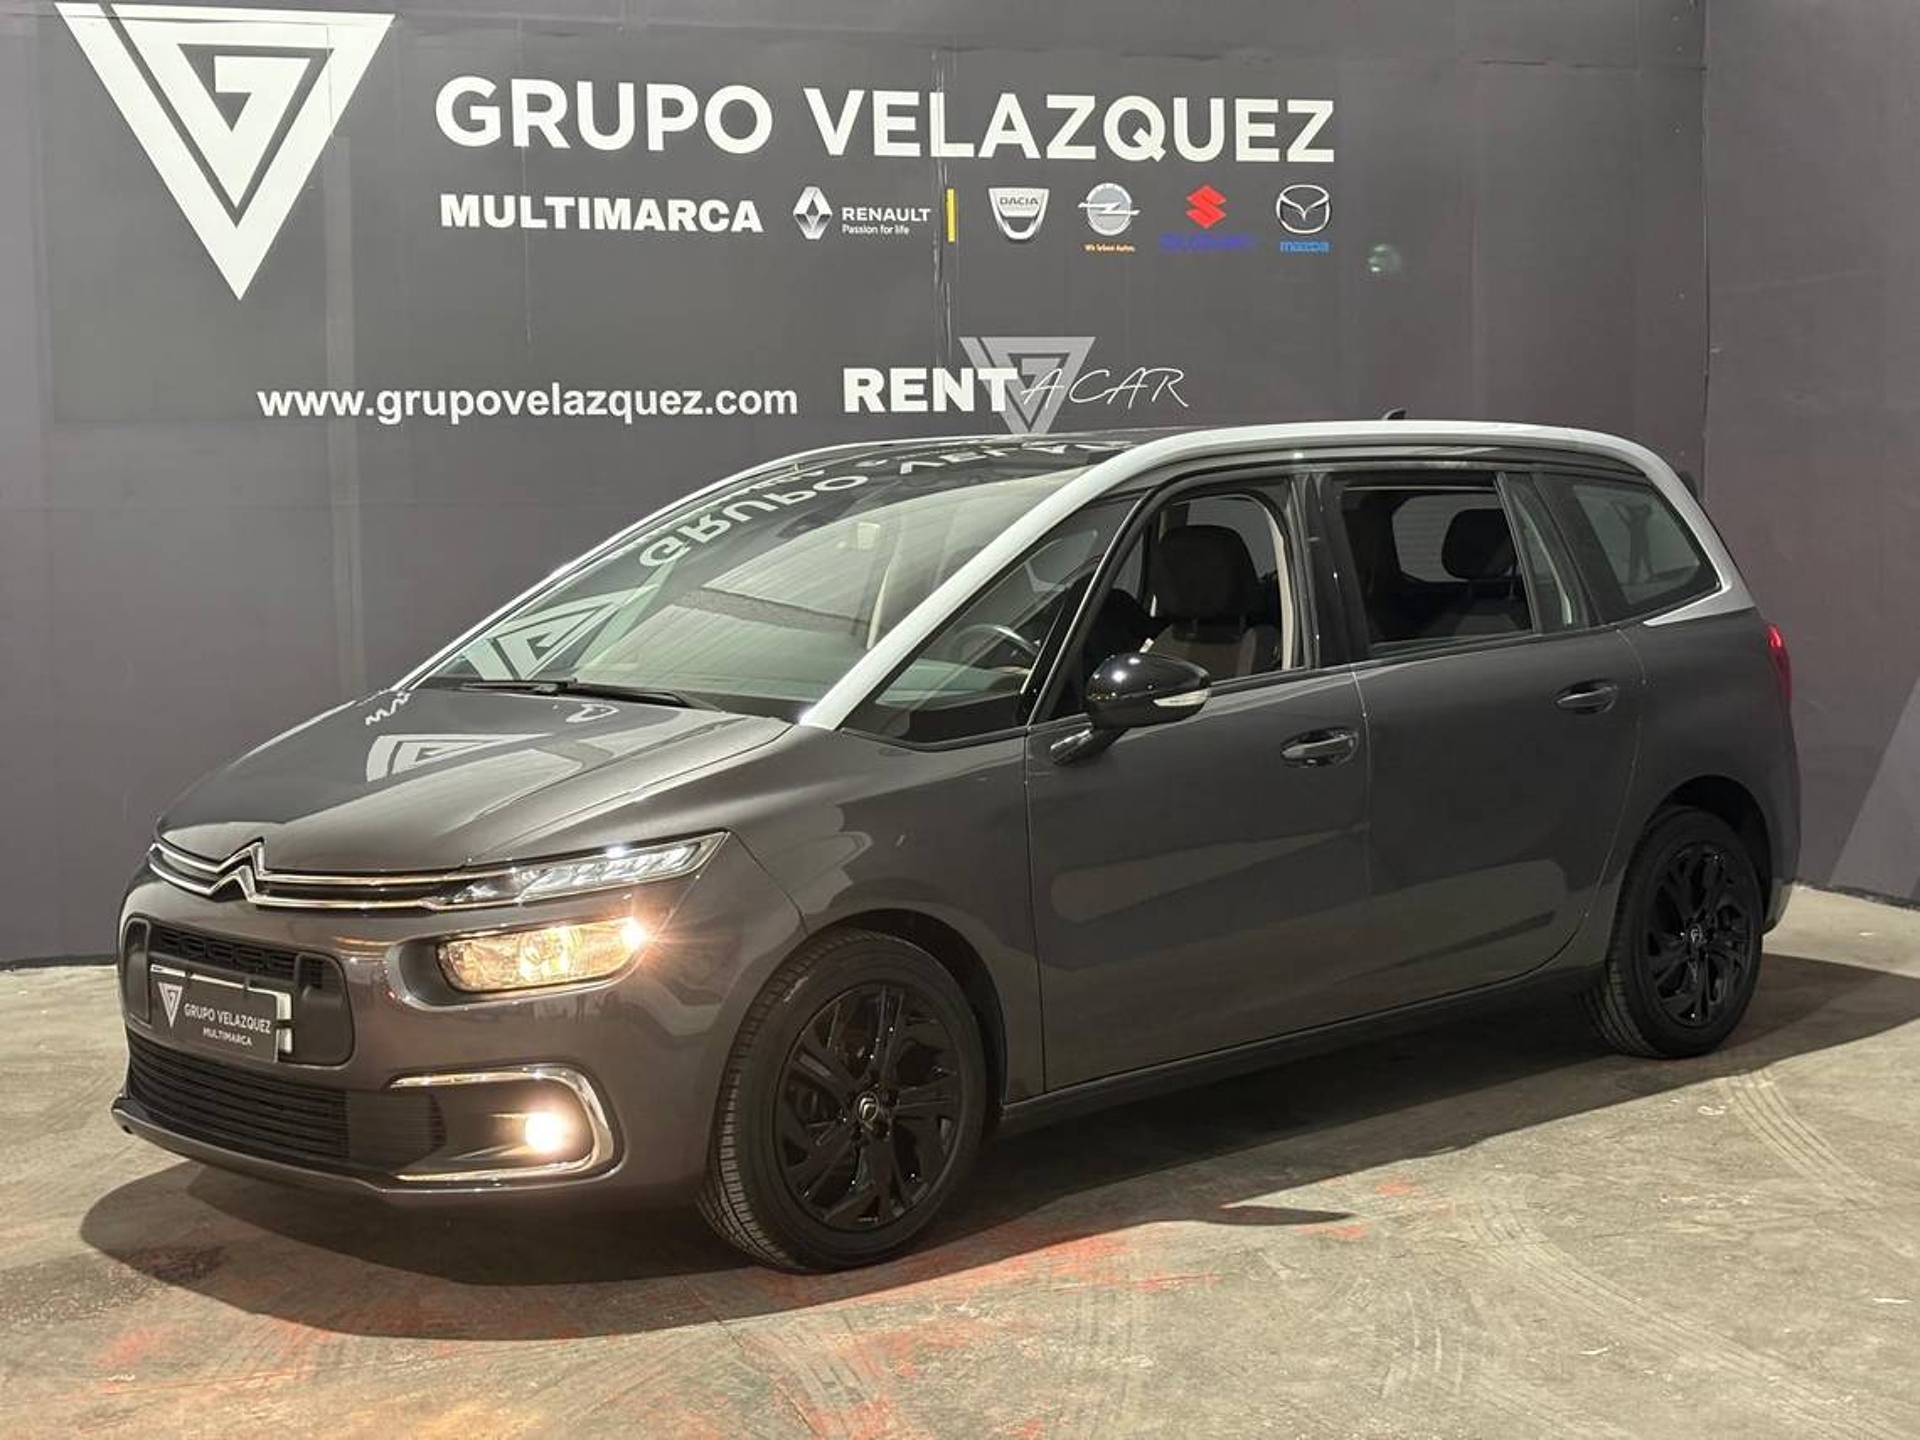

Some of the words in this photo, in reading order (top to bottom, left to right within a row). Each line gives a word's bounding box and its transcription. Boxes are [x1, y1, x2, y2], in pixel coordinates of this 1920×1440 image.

[435, 76, 773, 154] GRUPO
[803, 87, 1335, 163] VELAZQUEZ
[440, 194, 764, 233] MULTIMARCA
[842, 206, 931, 222] RENAULT
[1000, 196, 1039, 206] DACIA
[842, 224, 878, 235] Passion
[880, 224, 894, 235] for
[894, 224, 910, 235] life
[257, 382, 799, 425] www.grupovelazquez.com
[843, 367, 1019, 413] RENT
[1020, 367, 1065, 410] A
[1068, 366, 1189, 410] CAR
[184, 1003, 215, 1021] GRUPO
[217, 1010, 271, 1034] VELAZQUEZ
[202, 1027, 252, 1046] MULTIMARCA
